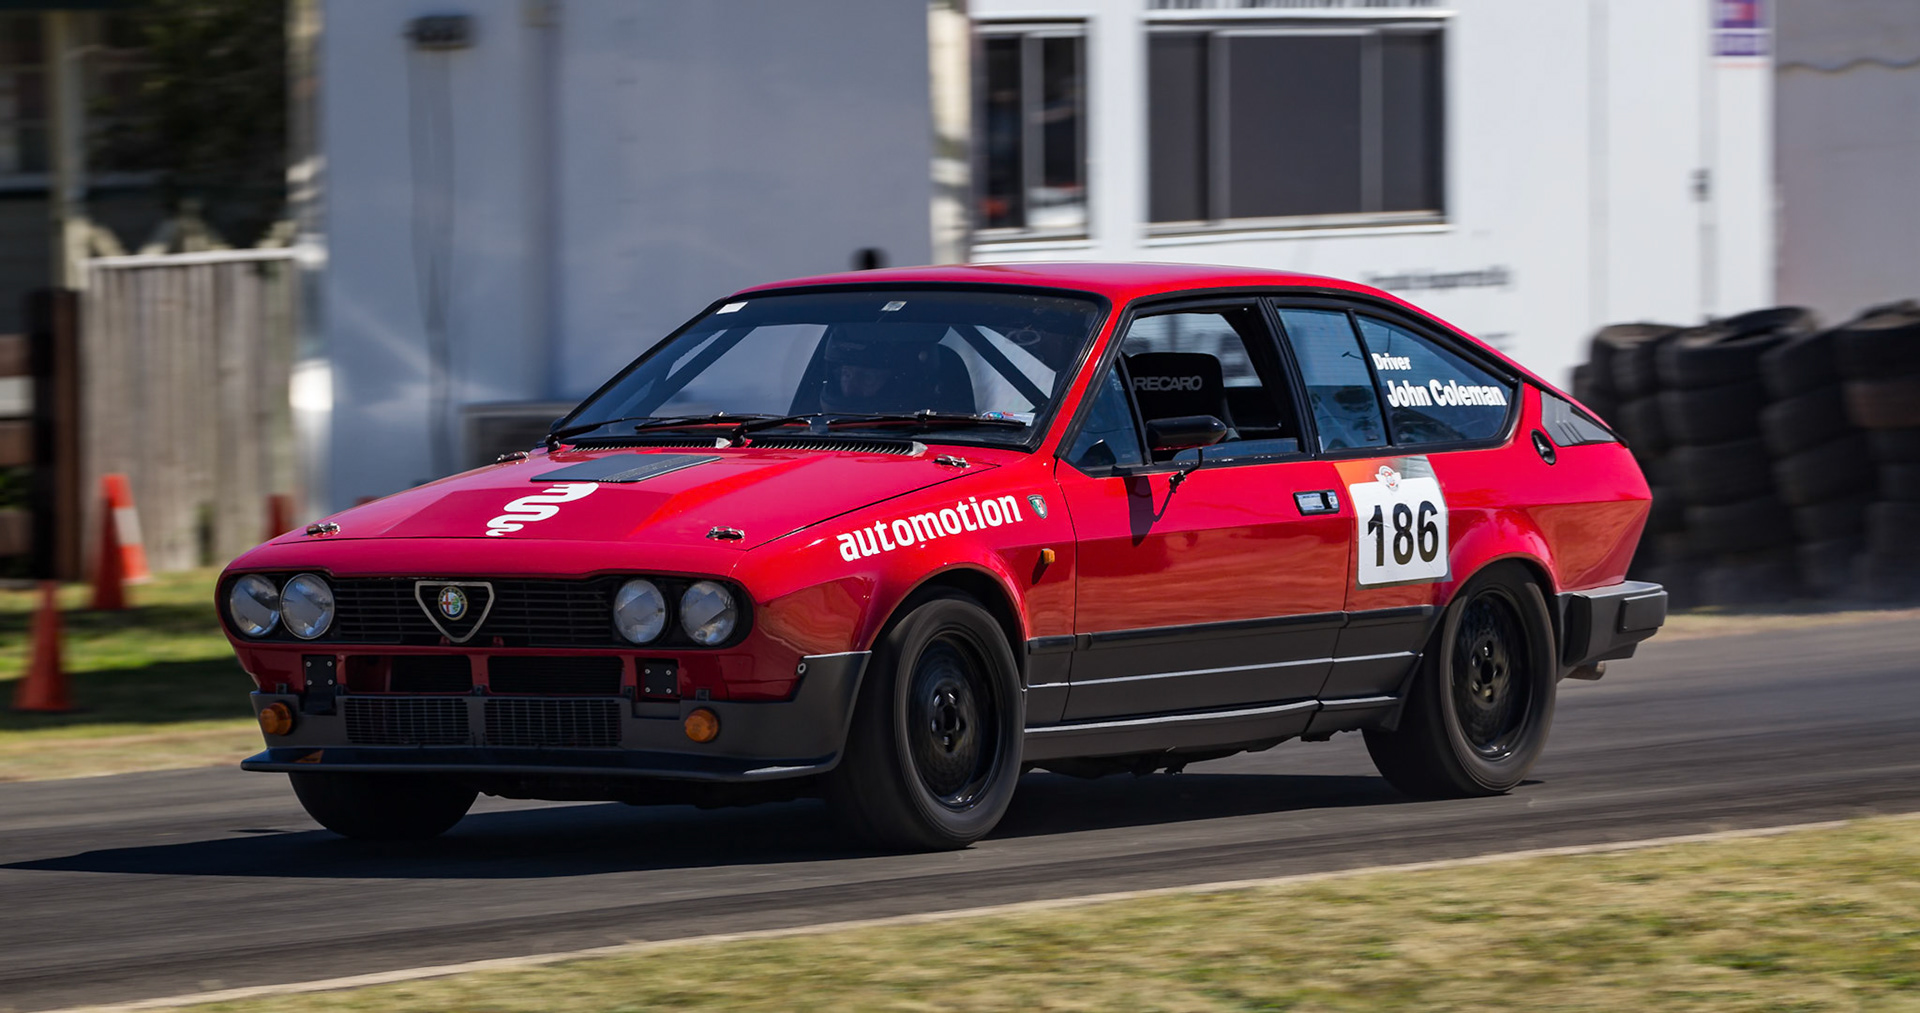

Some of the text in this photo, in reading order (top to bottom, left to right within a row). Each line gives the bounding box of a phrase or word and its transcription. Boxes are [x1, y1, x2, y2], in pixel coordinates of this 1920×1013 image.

[1371, 353, 1412, 370] Driver
[1132, 375, 1203, 391] RECARO
[1387, 379, 1508, 408] John Coleman
[836, 495, 1023, 562] automotion
[1367, 500, 1439, 567] 186
